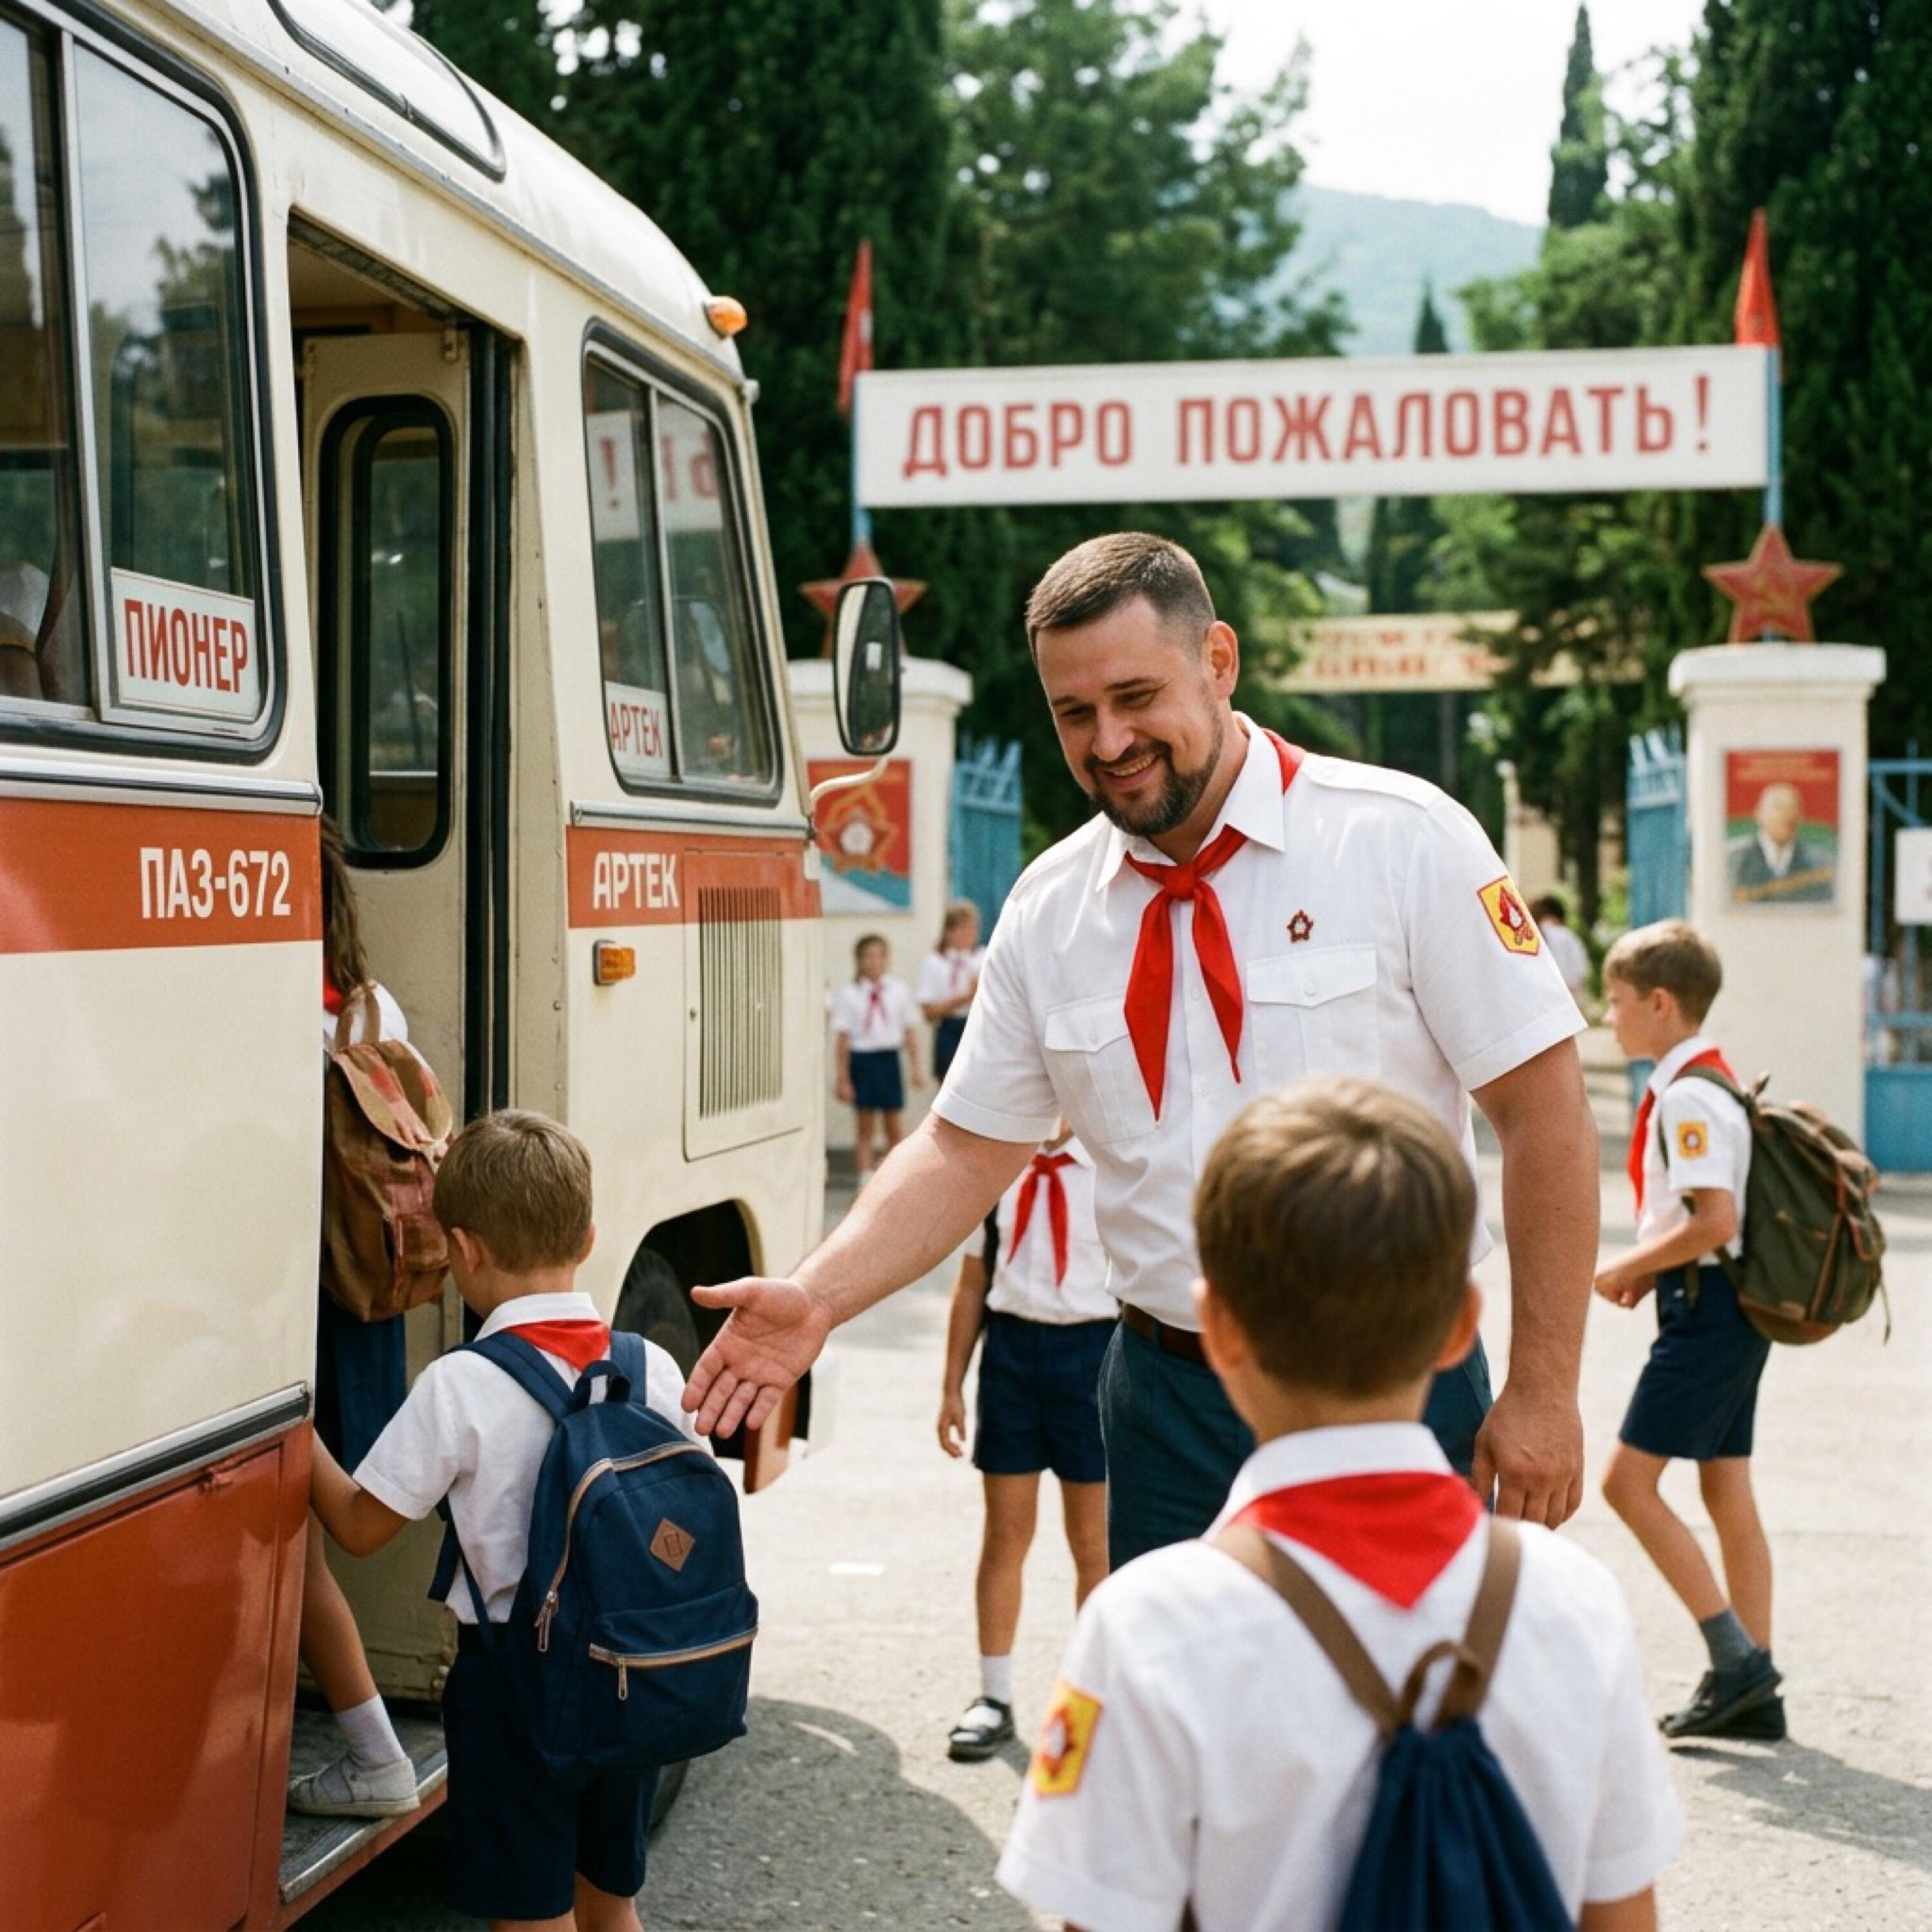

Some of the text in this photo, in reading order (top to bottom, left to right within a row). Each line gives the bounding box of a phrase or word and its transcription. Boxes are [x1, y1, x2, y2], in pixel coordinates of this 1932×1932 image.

[900, 374, 1711, 480] ДОБРО ПОЖАЛОВАТЬ!
[123, 599, 249, 694] ПИОНЕР
[608, 701, 663, 758] АРТЕК
[140, 846, 292, 919] ПАЗ-672
[592, 851, 680, 910] АРТЕК
